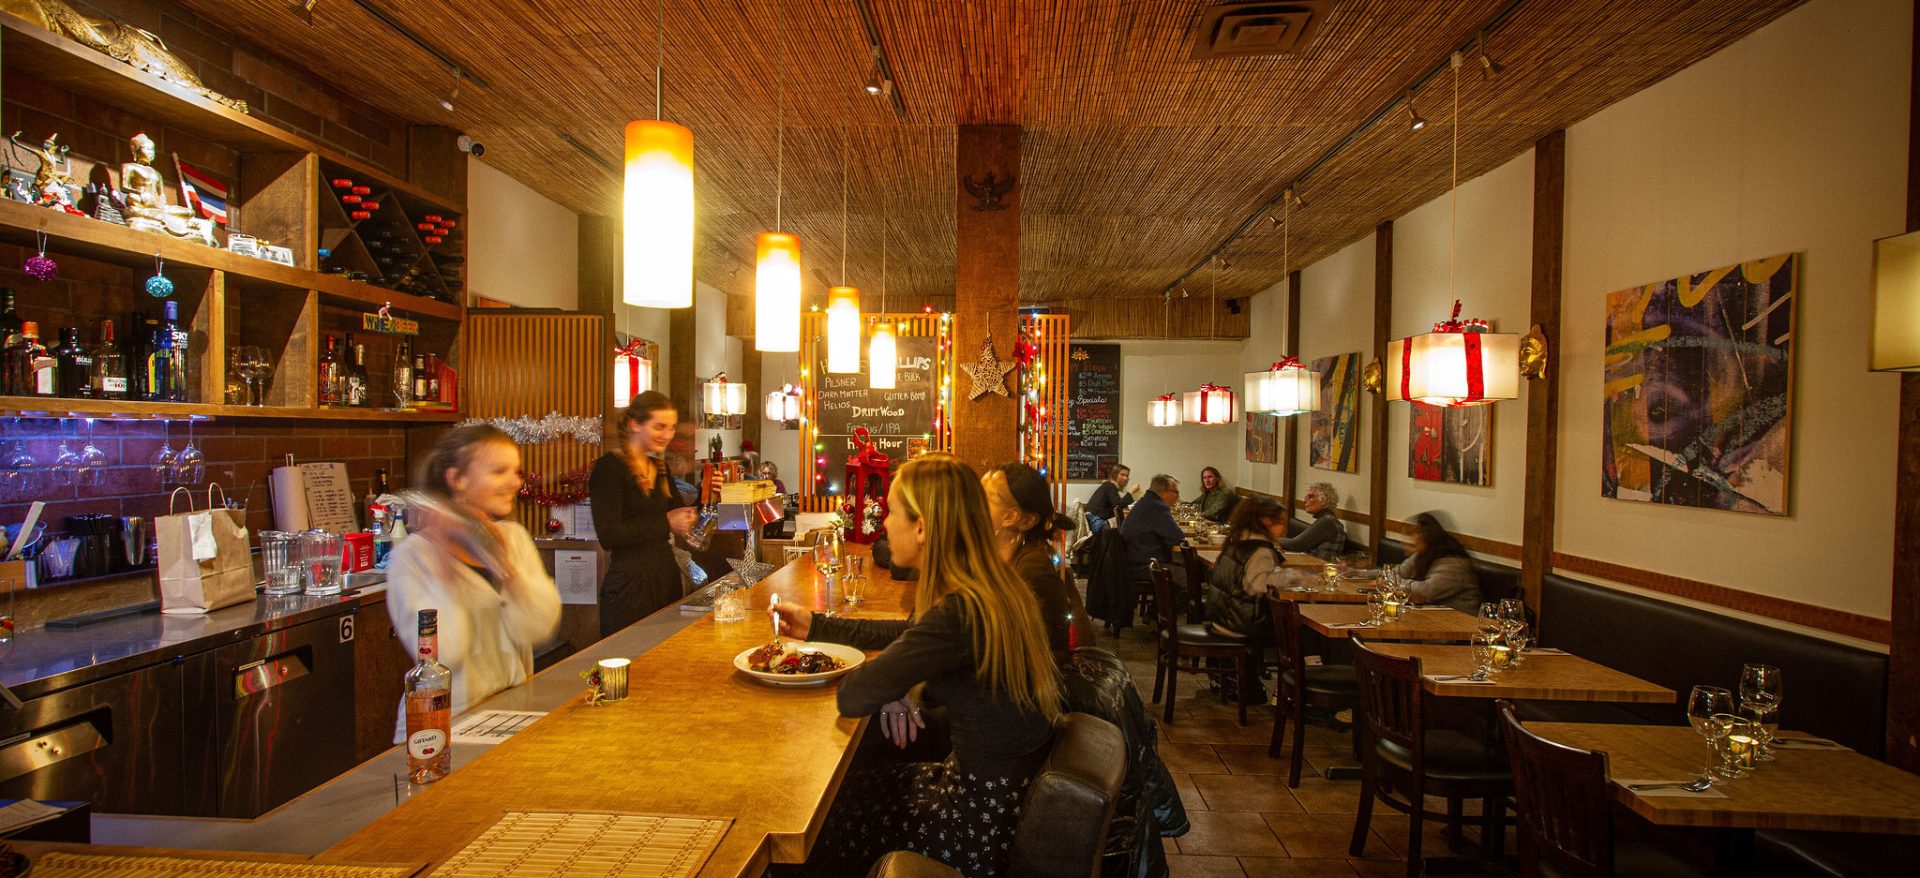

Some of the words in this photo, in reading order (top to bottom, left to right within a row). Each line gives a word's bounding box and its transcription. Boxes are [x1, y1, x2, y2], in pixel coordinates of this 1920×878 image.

[171, 331, 188, 340] SKY
[896, 356, 932, 370] LLIPS
[825, 377, 857, 389] PILSNER
[818, 391, 839, 400] DARK
[839, 389, 869, 398] MATTER
[823, 401, 851, 410] HELIOS
[879, 438, 903, 449] Hour
[341, 617, 353, 640] 6
